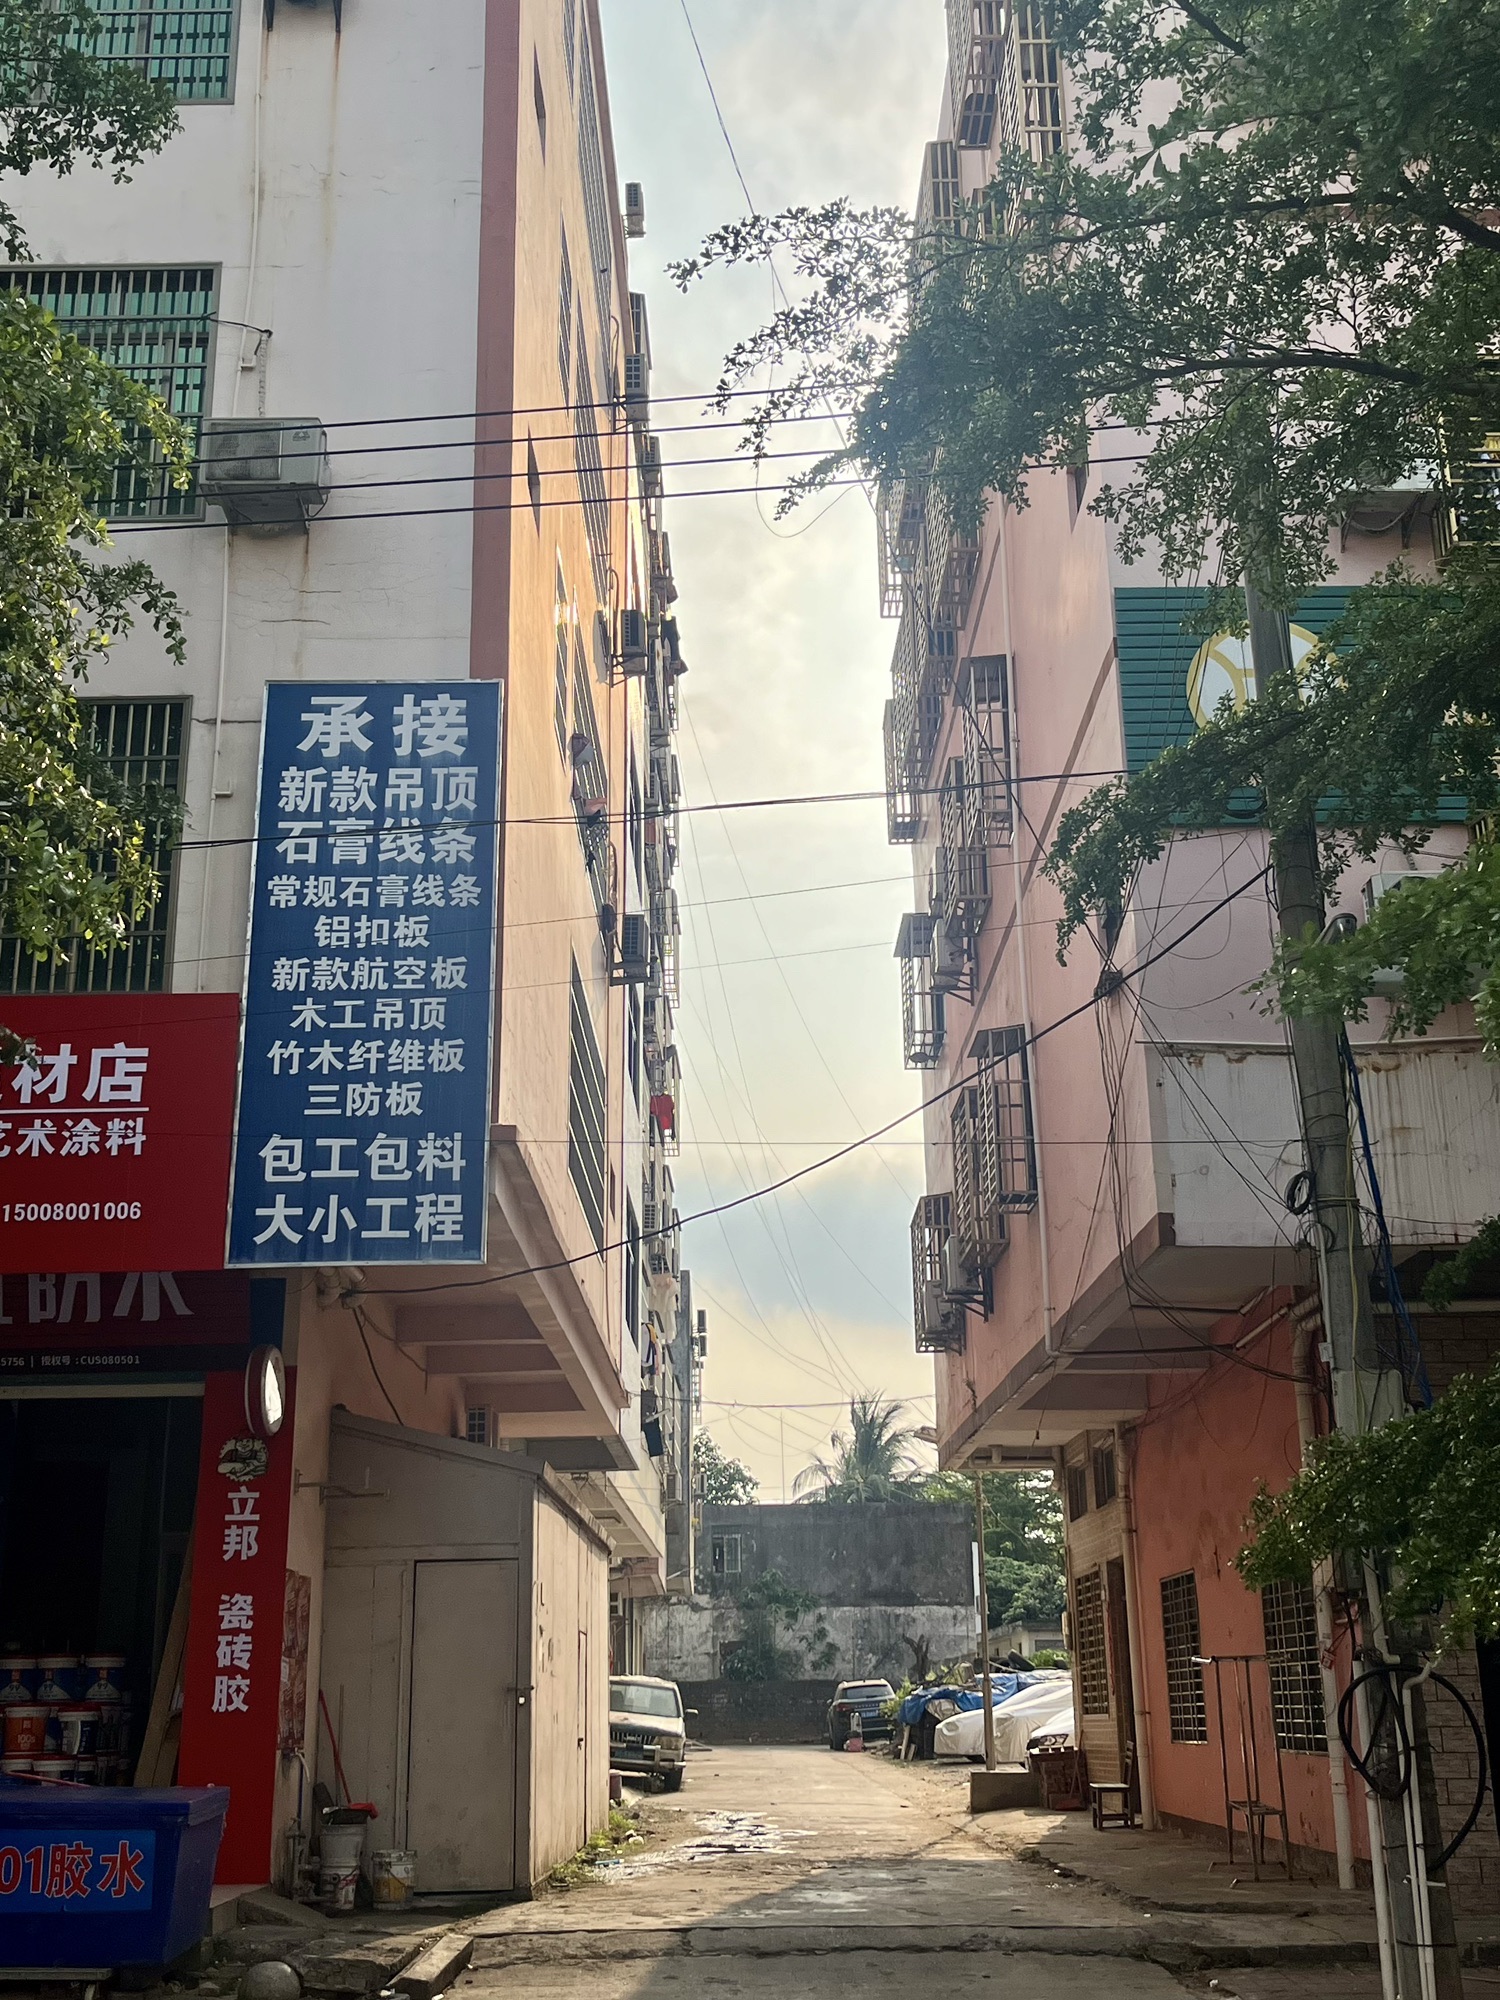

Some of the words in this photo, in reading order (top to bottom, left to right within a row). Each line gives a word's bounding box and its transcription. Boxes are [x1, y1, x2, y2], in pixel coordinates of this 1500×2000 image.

[296, 693, 469, 757] 承接
[277, 765, 479, 813] 新款吊顶
[275, 816, 477, 865] 石膏线条
[267, 873, 482, 909] 常规石膏线条
[313, 914, 431, 949] 铝扣板
[271, 955, 469, 992] 新款航空板
[289, 997, 448, 1032] 木工吊顶
[0, 1041, 150, 1104] 材店
[266, 1038, 466, 1075] 竹木纤维板
[303, 1081, 424, 1117] 三防板
[257, 1131, 467, 1183] 包工包料
[2, 1201, 142, 1222] 15008001006
[252, 1193, 465, 1246] 大小工程
[0, 1271, 195, 1325] 防水
[222, 1485, 260, 1562] 立邦
[211, 1592, 254, 1713] 瓷砖胶
